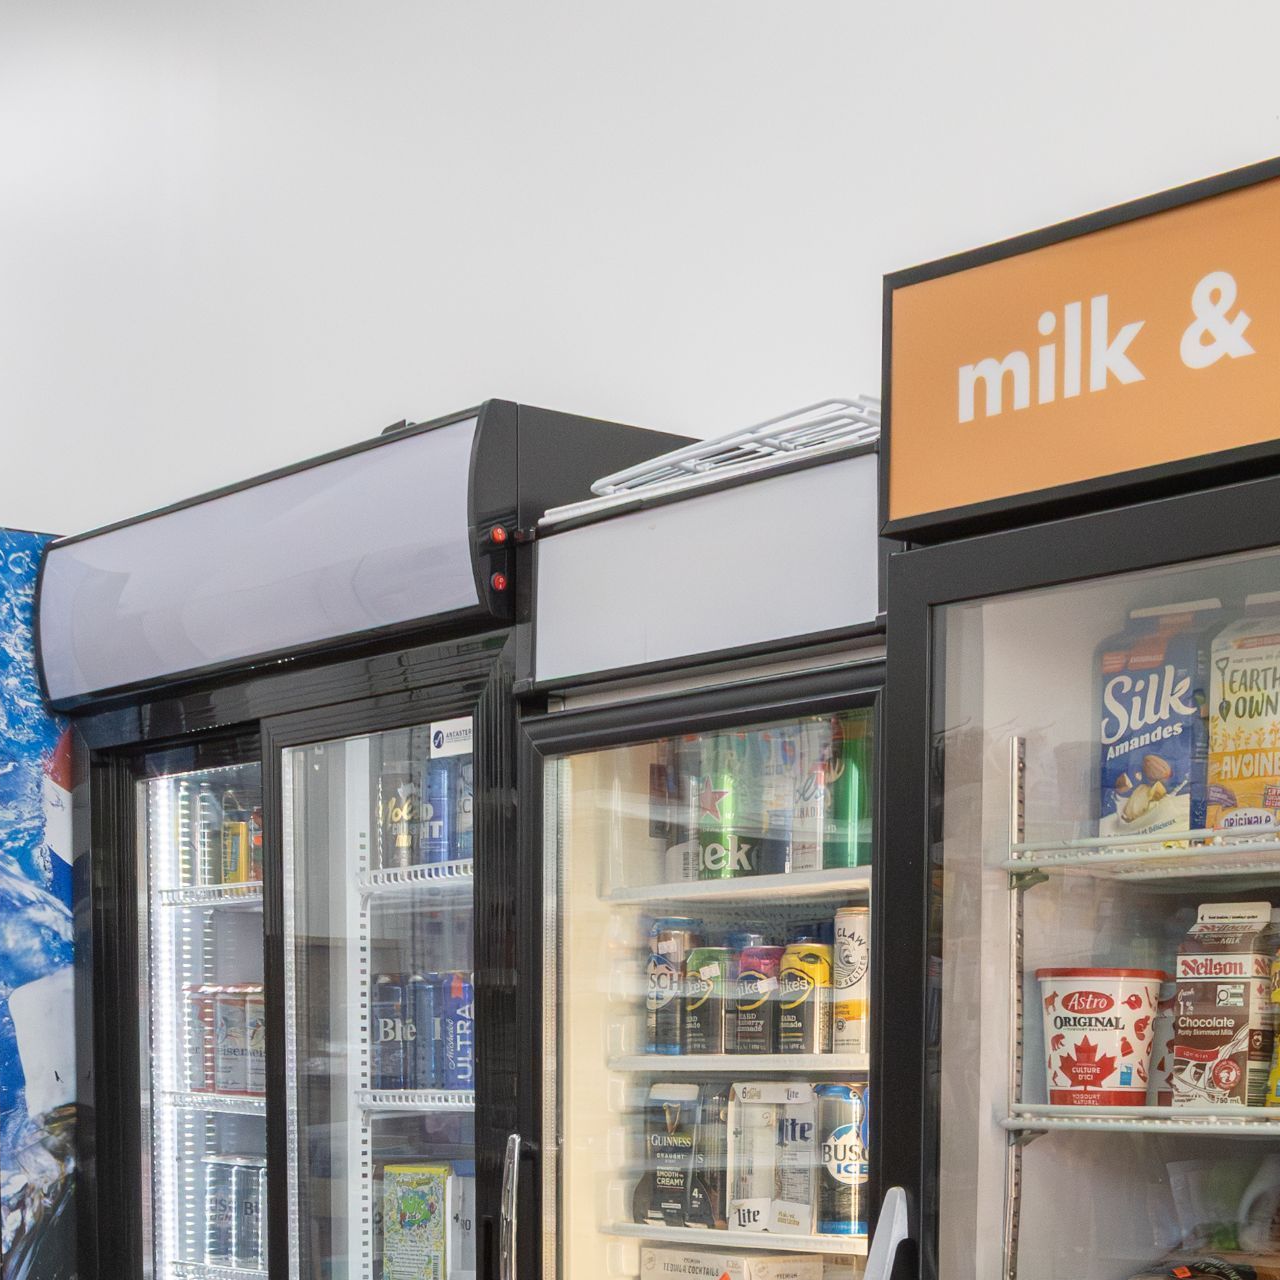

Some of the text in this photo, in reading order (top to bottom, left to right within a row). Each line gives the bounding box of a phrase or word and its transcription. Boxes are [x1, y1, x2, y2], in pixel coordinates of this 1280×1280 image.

[957, 293, 1146, 424] milk
[1180, 270, 1256, 370] &
[1100, 664, 1197, 745] Silk
[1234, 694, 1279, 719] OWN
[1106, 722, 1184, 762] Amandes
[837, 927, 866, 947] CLAW
[1181, 958, 1247, 977] Neilson
[1068, 993, 1108, 1012] Astro
[1054, 1015, 1126, 1031] ORIGINAL
[1178, 1016, 1235, 1028] Chocolate
[1220, 1028, 1233, 1036] Milk
[456, 1004, 474, 1080] ULTRA
[1078, 1073, 1094, 1081] D'ICI
[786, 1087, 800, 1100] Lite
[651, 1133, 692, 1148] GUINNESS
[776, 1117, 813, 1147] Lite
[822, 1143, 869, 1164] BUSC
[835, 1163, 869, 1175] ICE
[656, 1178, 685, 1187] CREAMY
[737, 1207, 761, 1227] Lite
[663, 1262, 720, 1277] TEQUILA COCKTAILS
